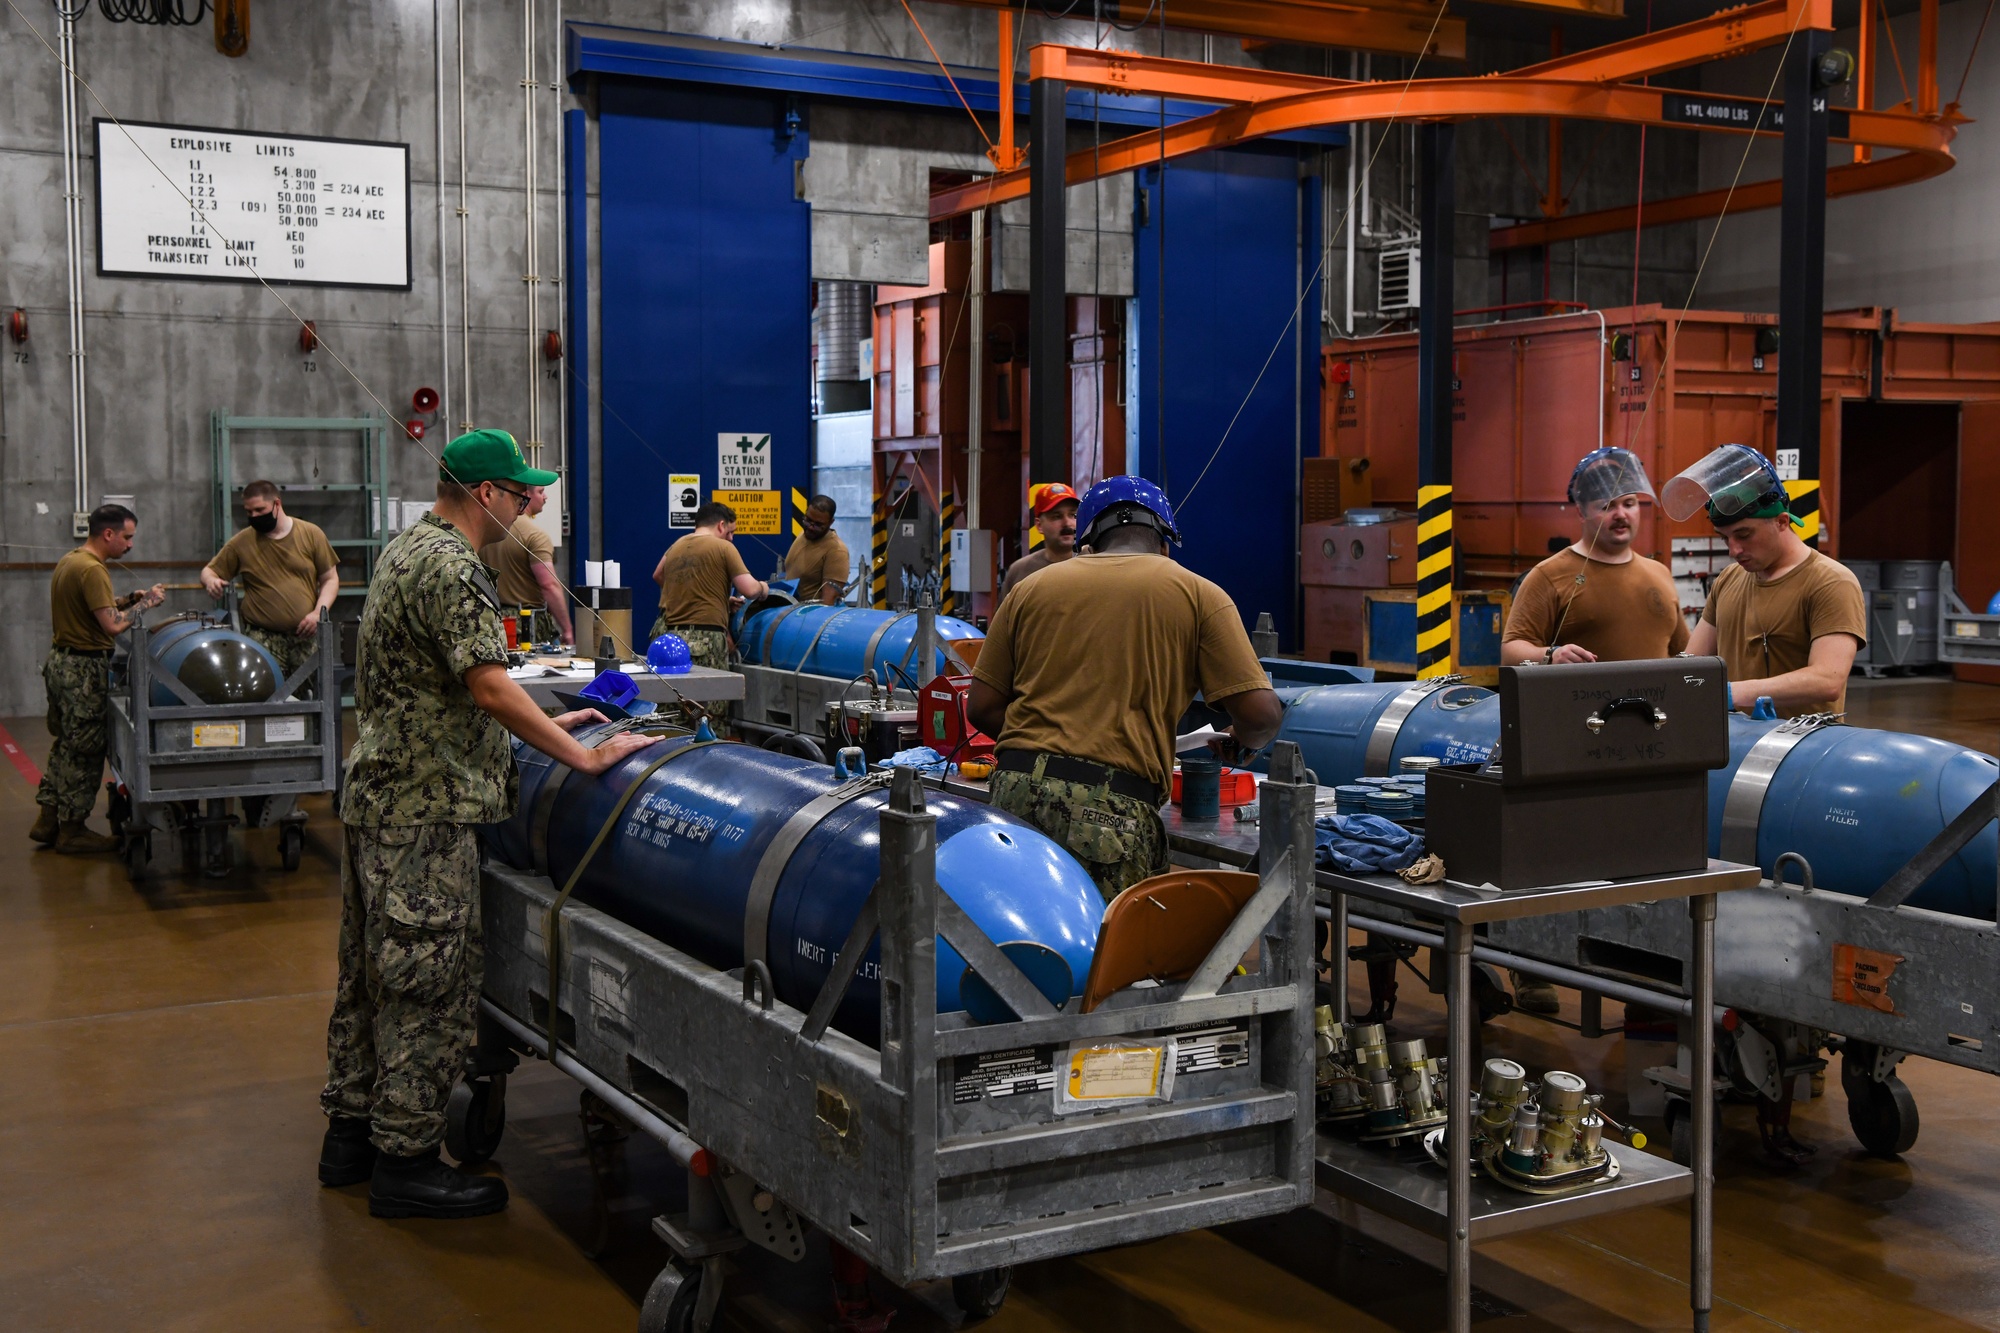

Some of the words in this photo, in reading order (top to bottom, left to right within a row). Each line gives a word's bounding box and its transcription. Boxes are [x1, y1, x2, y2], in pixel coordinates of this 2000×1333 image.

[1685, 105, 1703, 117] SWL
[1706, 106, 1730, 119] 4000
[1732, 108, 1749, 121] LBS
[170, 138, 232, 153] EXPLOSIVE
[256, 145, 295, 157] LIMITS
[190, 160, 201, 170] 1.1
[190, 172, 212, 184] 1.2.1
[341, 184, 360, 195] 234
[190, 186, 215, 197] 1.2.2
[190, 199, 217, 210] 1.2.3
[241, 202, 267, 213] (09)
[342, 207, 361, 218] 234
[191, 211, 205, 222] 1.3
[191, 225, 205, 235] 1.4
[148, 235, 212, 249] PERSONNEL
[225, 239, 255, 251] LIMIT
[292, 244, 304, 255] 50
[148, 251, 209, 265] TRANSIENT
[225, 255, 257, 267] LIMIT
[294, 258, 305, 269] 10
[14, 352, 29, 364] 72
[303, 361, 317, 372] 73
[546, 370, 558, 380] 74
[722, 455, 738, 465] EYE
[742, 455, 765, 465] WASH
[1777, 454, 1783, 466] S
[1788, 453, 1797, 466] 12
[724, 466, 761, 476] STATION
[722, 478, 741, 487] THIS
[745, 478, 764, 487] WAY
[728, 493, 764, 503] CAUTION
[1571, 689, 1612, 700] DEVICE
[1824, 814, 1859, 826] FILLER
[797, 937, 826, 964] INERT
[832, 952, 881, 980] FLER
[1855, 962, 1879, 974] PACKING
[1854, 972, 1867, 981] LIST
[1854, 981, 1881, 994] ENCLOSED
[1175, 1021, 1209, 1031] CONTENTS
[994, 1048, 1035, 1059] IDENTIFICATION
[1017, 1060, 1042, 1068] STORAGE
[960, 1071, 996, 1081] UNDERWATER
